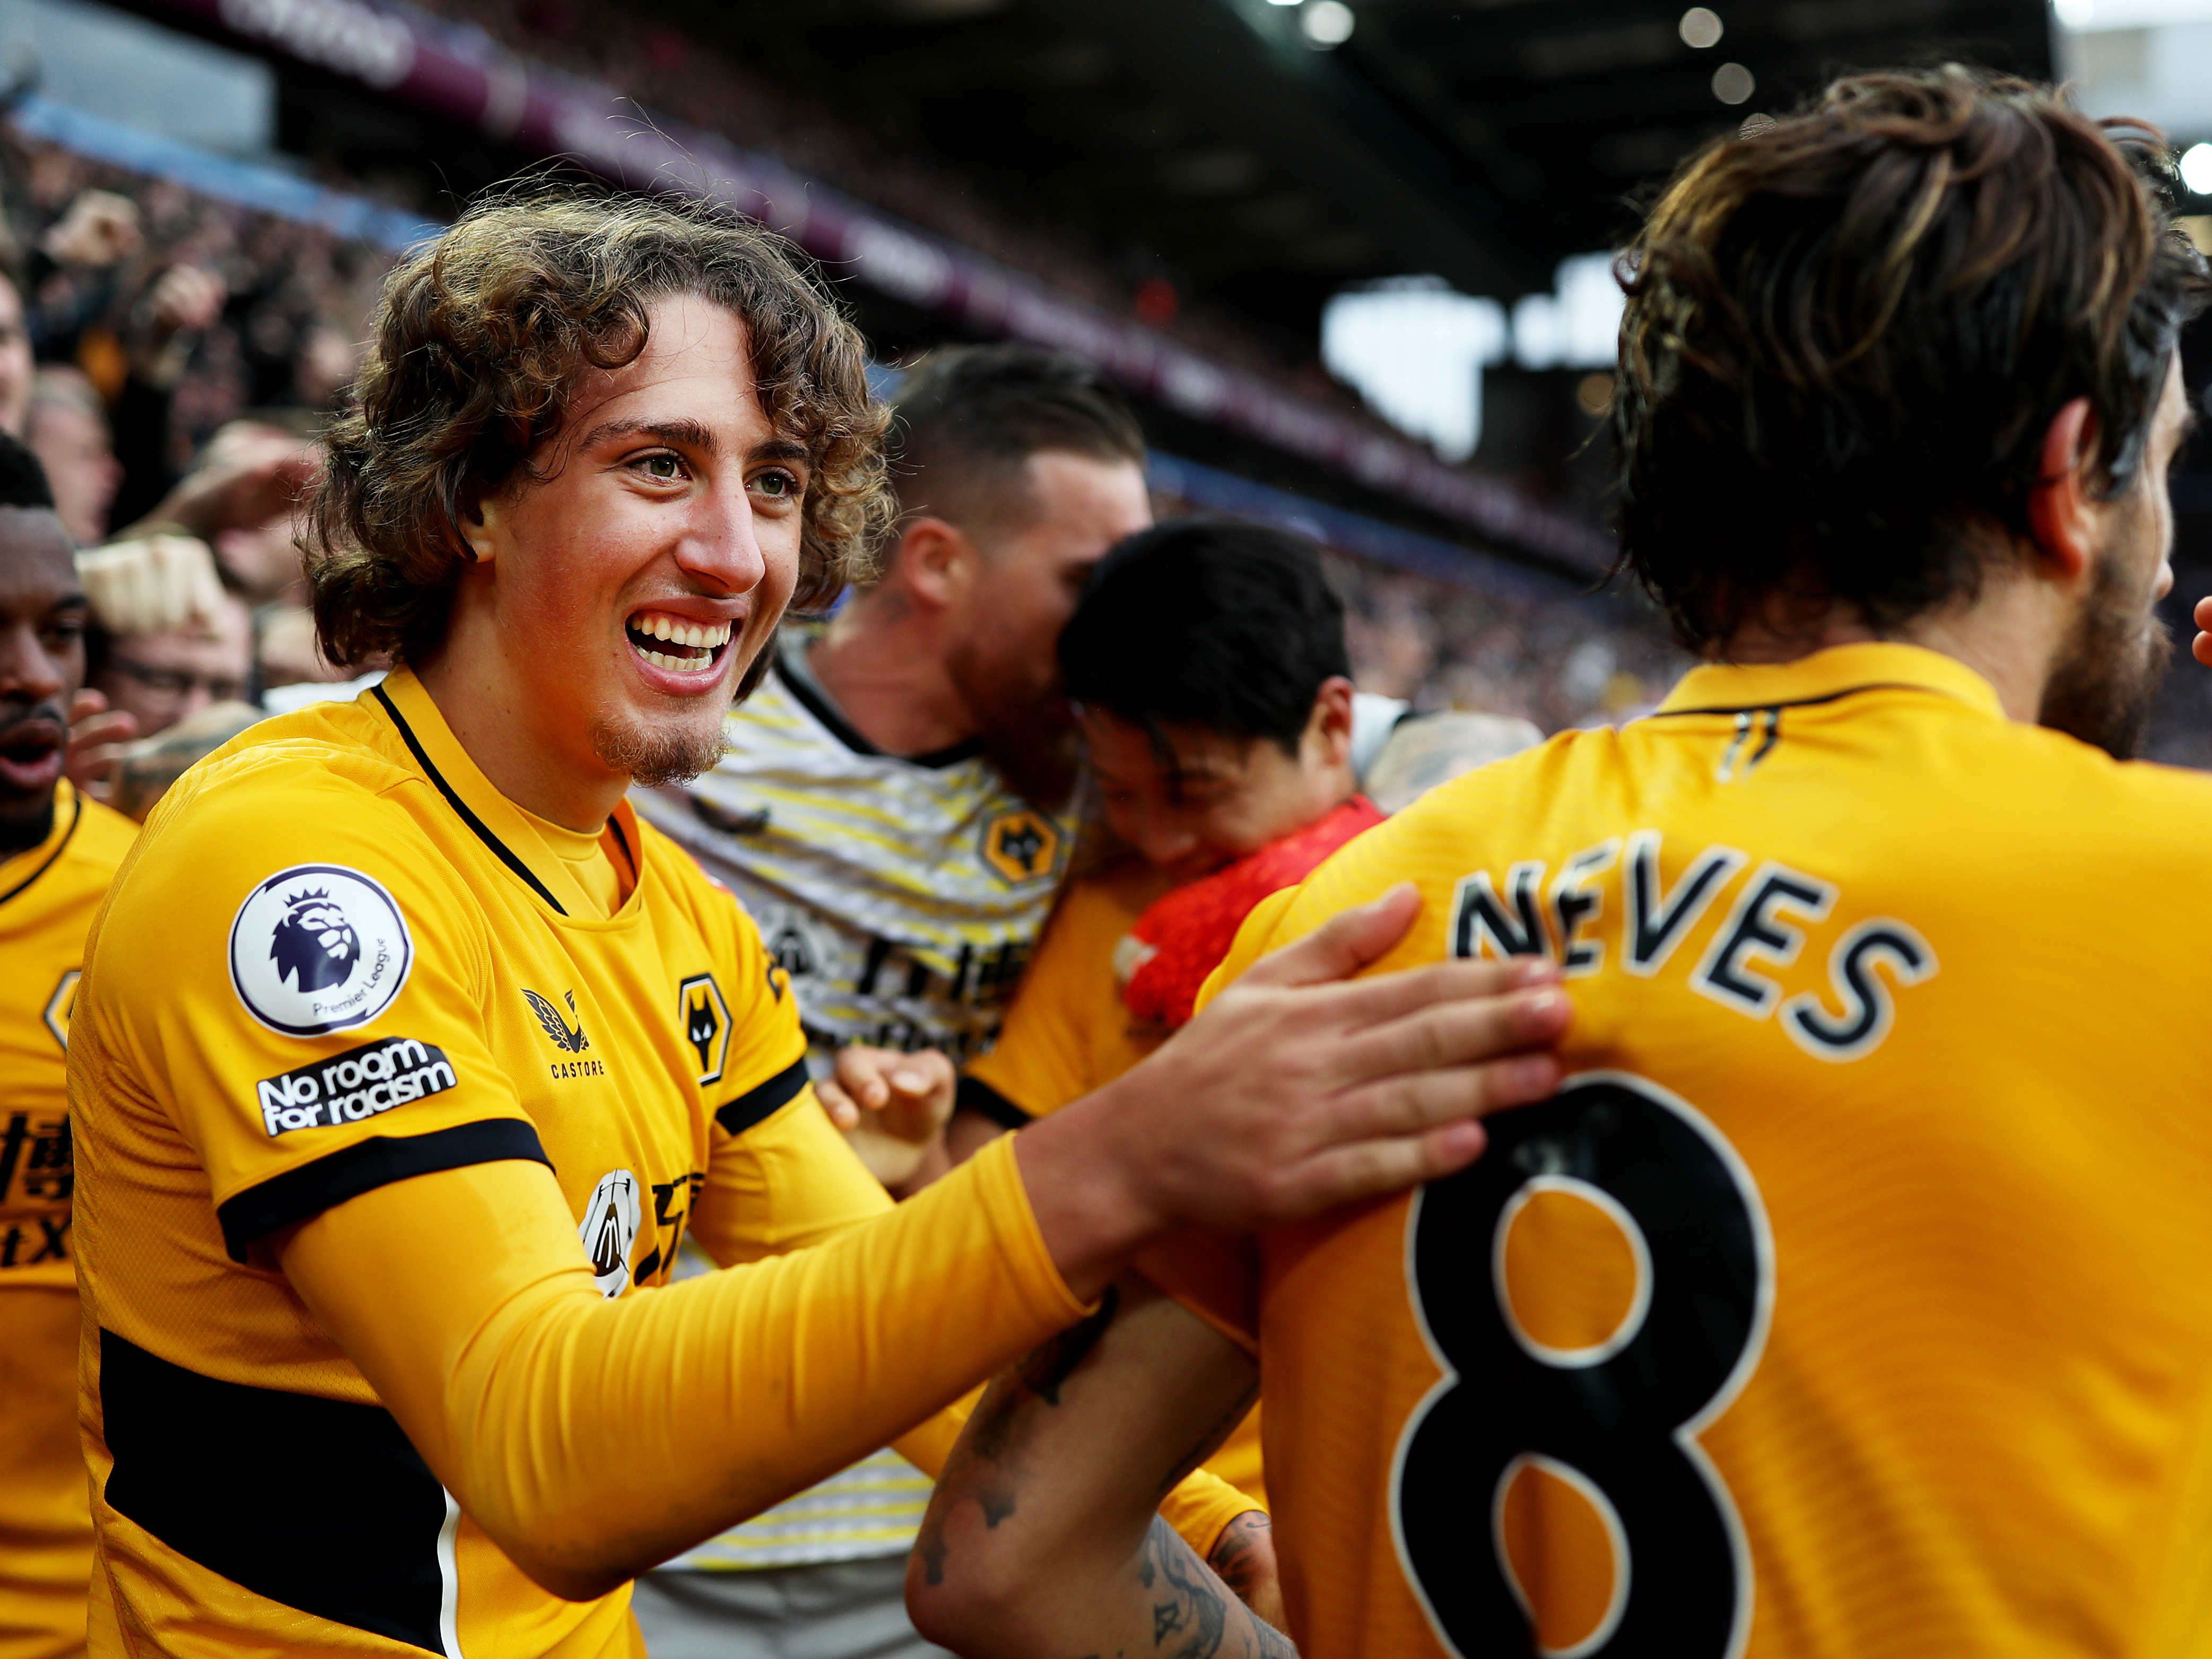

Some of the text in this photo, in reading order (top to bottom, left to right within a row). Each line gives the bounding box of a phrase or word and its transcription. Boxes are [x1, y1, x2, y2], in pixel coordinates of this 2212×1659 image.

[313, 938, 390, 1016] Premier League
[1452, 829, 1938, 1061] NEVES
[258, 1039, 429, 1109] No room
[264, 1061, 457, 1137] for racism
[551, 1060, 604, 1079] CASTORE
[1390, 1071, 1775, 1659] 8
